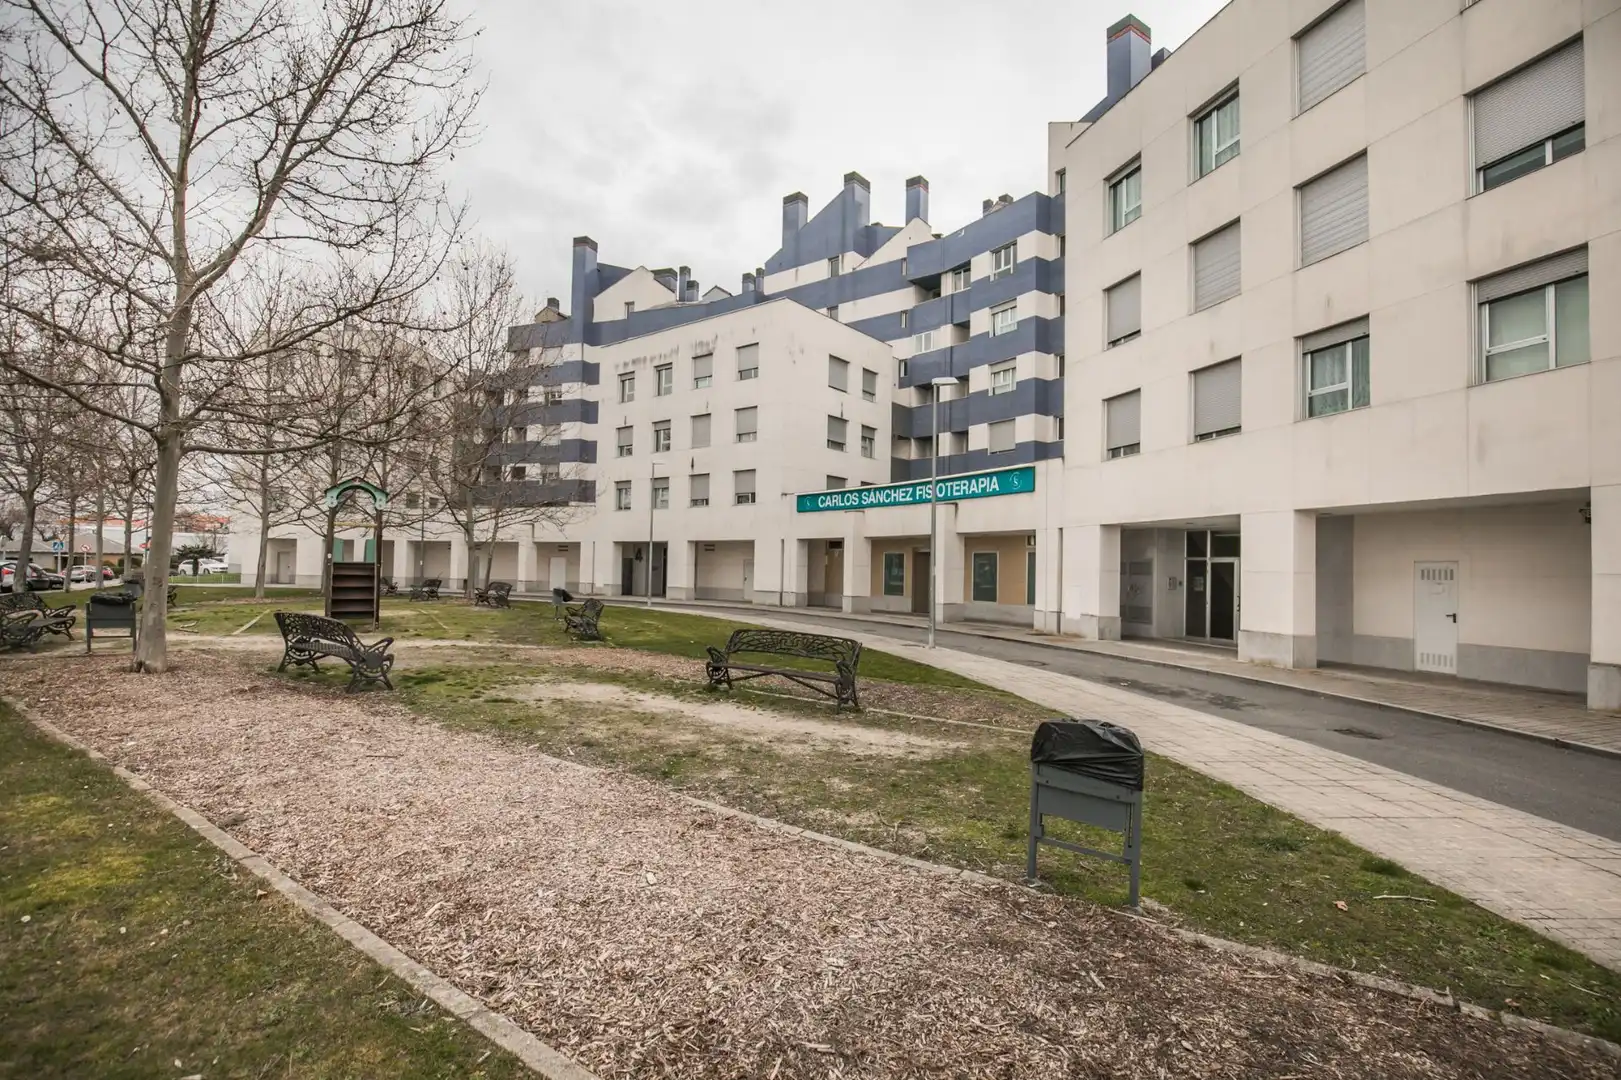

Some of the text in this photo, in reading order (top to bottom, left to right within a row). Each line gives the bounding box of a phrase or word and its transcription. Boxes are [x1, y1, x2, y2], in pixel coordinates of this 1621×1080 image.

[818, 493, 859, 508] CARLOS
[862, 487, 913, 504] SÁNCHEZ
[916, 476, 999, 499] FISOTERAPIA
